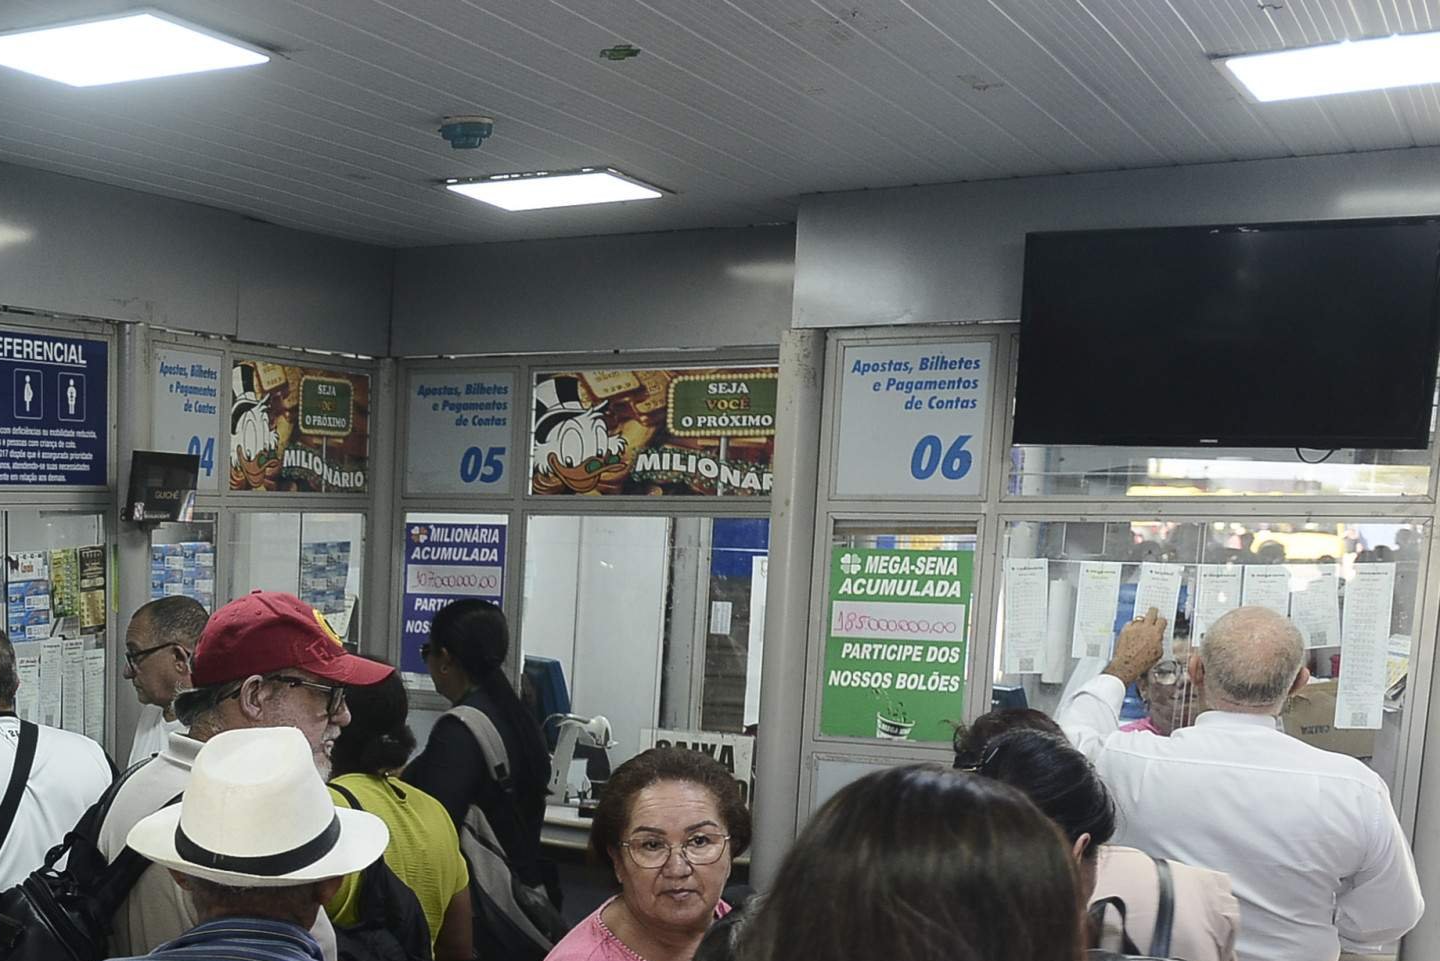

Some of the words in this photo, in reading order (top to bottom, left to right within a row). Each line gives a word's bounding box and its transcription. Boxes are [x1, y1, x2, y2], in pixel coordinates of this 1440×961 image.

[159, 361, 189, 378] Apostas,
[190, 364, 217, 380] Bilhetes
[851, 359, 914, 375] Apostas,
[919, 355, 981, 371] Bilhetes
[169, 382, 174, 393] e
[175, 381, 217, 397] Pagamentos
[317, 384, 337, 396] SEJA
[417, 384, 461, 398] Apostas,
[464, 382, 509, 396] Bilhetes
[707, 381, 749, 395] SEJA
[872, 381, 881, 392] e
[885, 377, 978, 394] Pagamentos
[184, 399, 193, 413] de
[194, 401, 216, 415] Contas
[432, 402, 439, 411] e
[441, 399, 508, 414] Pagamentos
[705, 395, 750, 410] VOCÊ
[904, 395, 923, 410] de
[928, 395, 978, 410] Contas
[305, 415, 312, 425] O
[312, 414, 346, 427] PRÓXIMO
[455, 414, 469, 427] de
[472, 414, 507, 427] Contas
[682, 416, 693, 428] O
[697, 412, 773, 428] PRÓXIMO
[460, 446, 506, 484] 05
[910, 434, 973, 481] 06
[283, 449, 364, 487] MILIONÁRIO
[411, 546, 499, 562] ACUMULADA
[864, 555, 958, 576] MEGA-SENA
[839, 577, 961, 598] ACUMULADA
[841, 642, 923, 662] PARTICIPE
[925, 646, 960, 664] DOS
[828, 669, 892, 689] NOSSOS
[895, 671, 960, 693] BOLÕES
